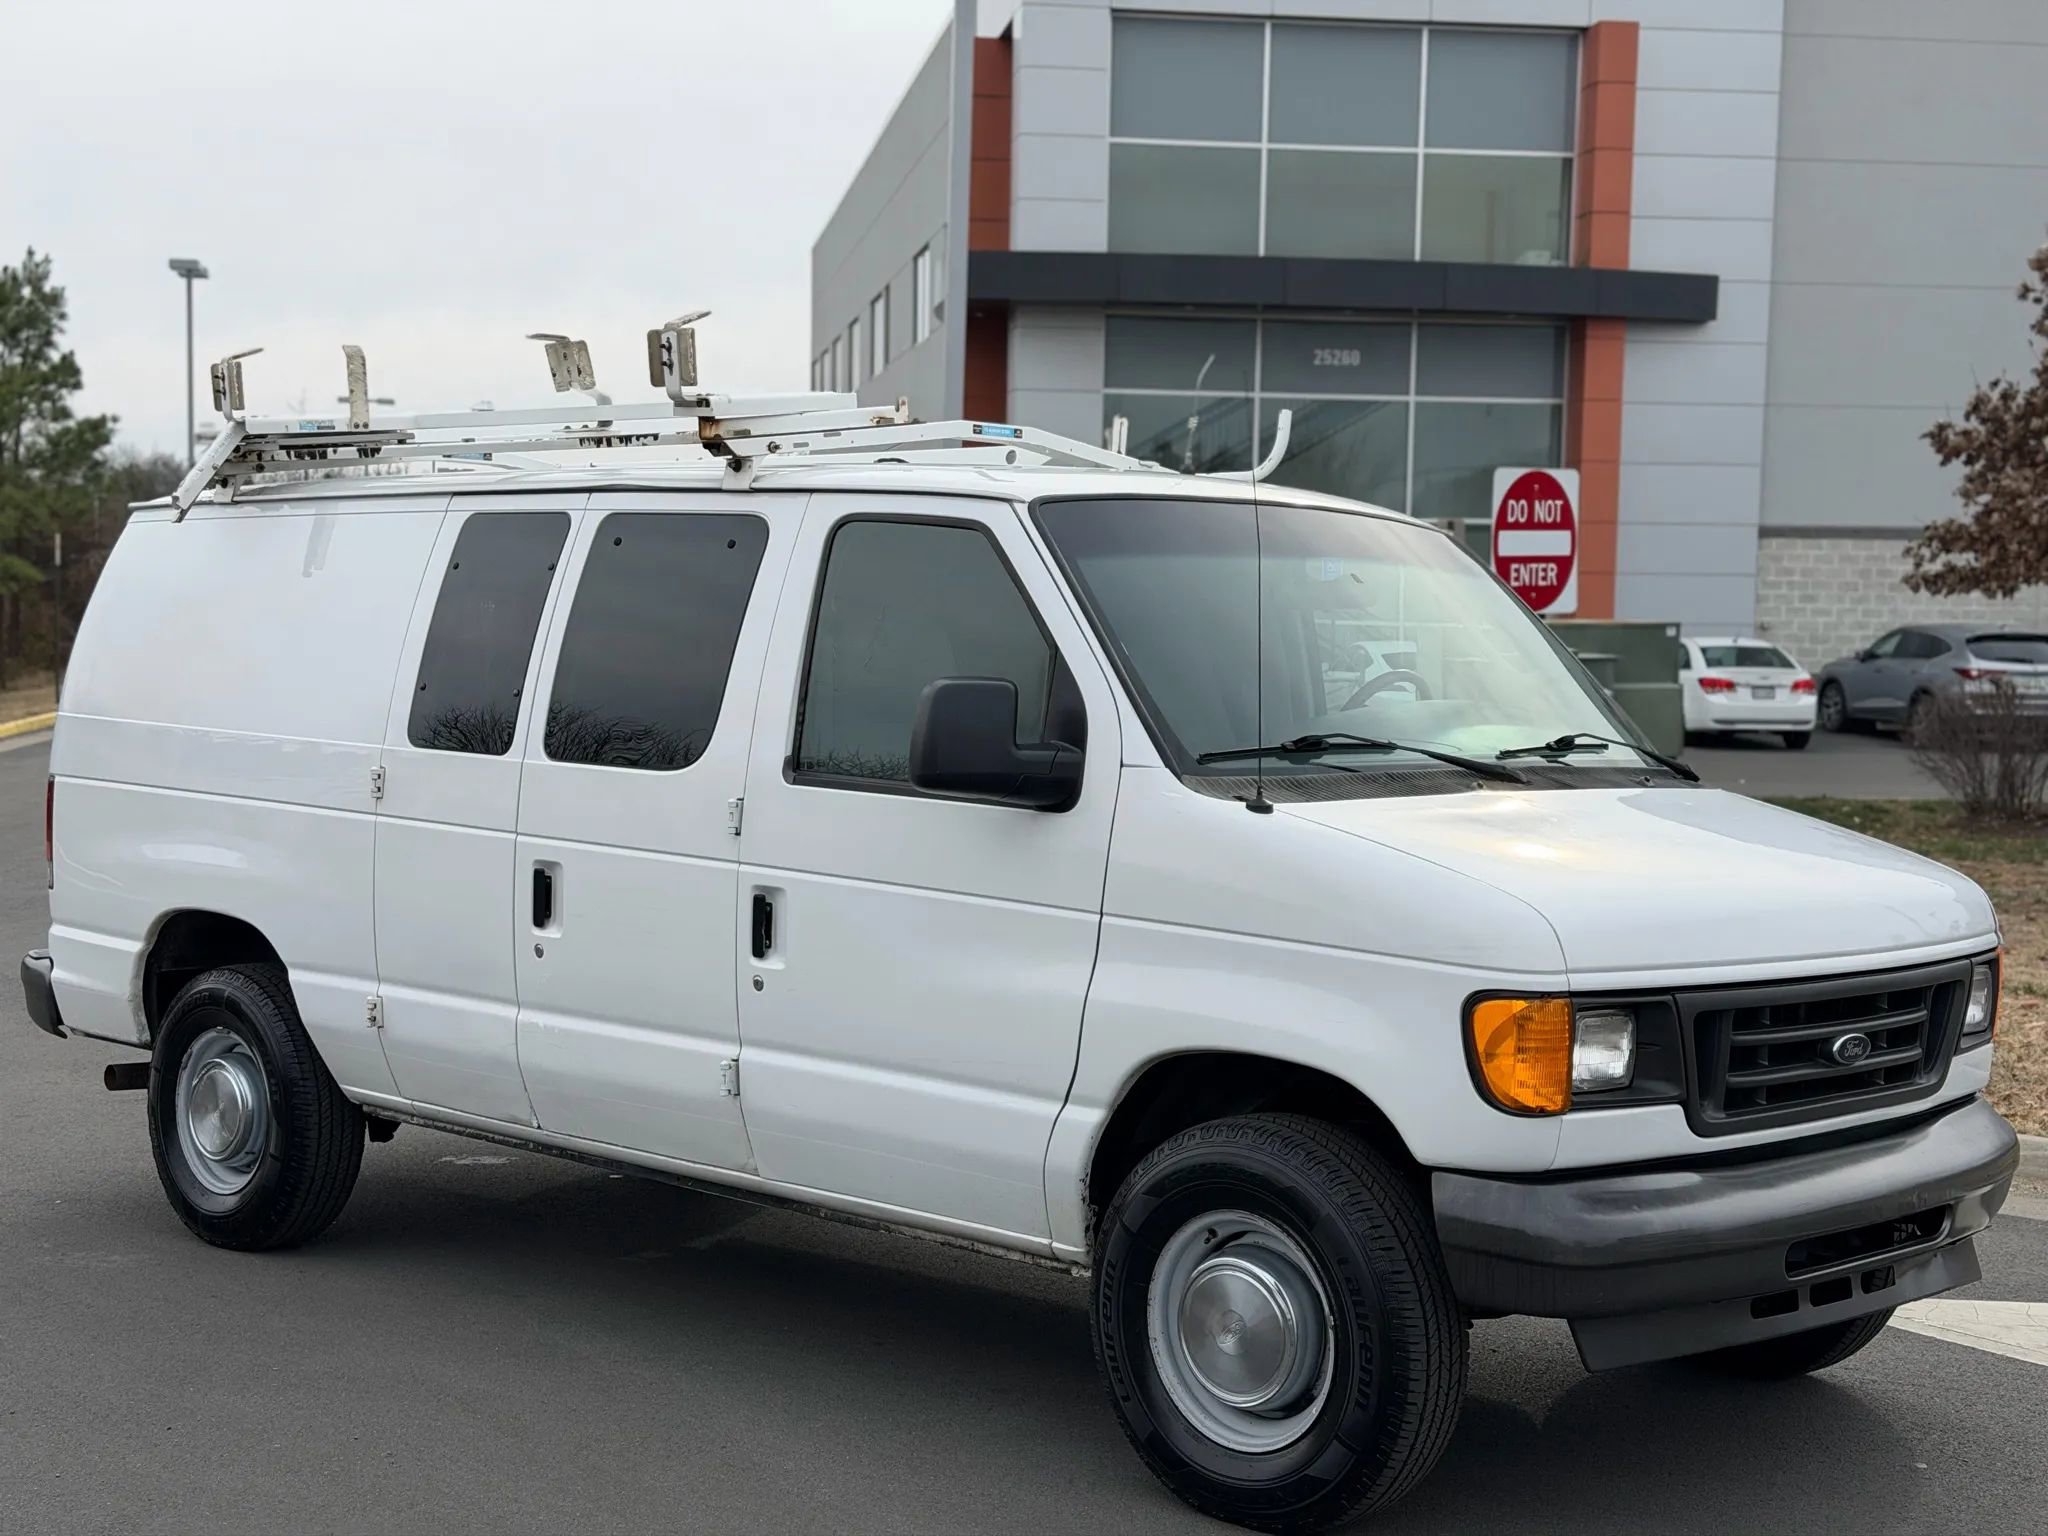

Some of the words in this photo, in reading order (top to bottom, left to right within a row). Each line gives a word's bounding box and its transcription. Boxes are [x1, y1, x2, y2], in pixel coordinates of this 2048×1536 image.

[1507, 500, 1528, 524] DO
[1534, 500, 1563, 524] NOT
[1510, 562, 1557, 587] ENTER
[1845, 1040, 1864, 1057] Ford
